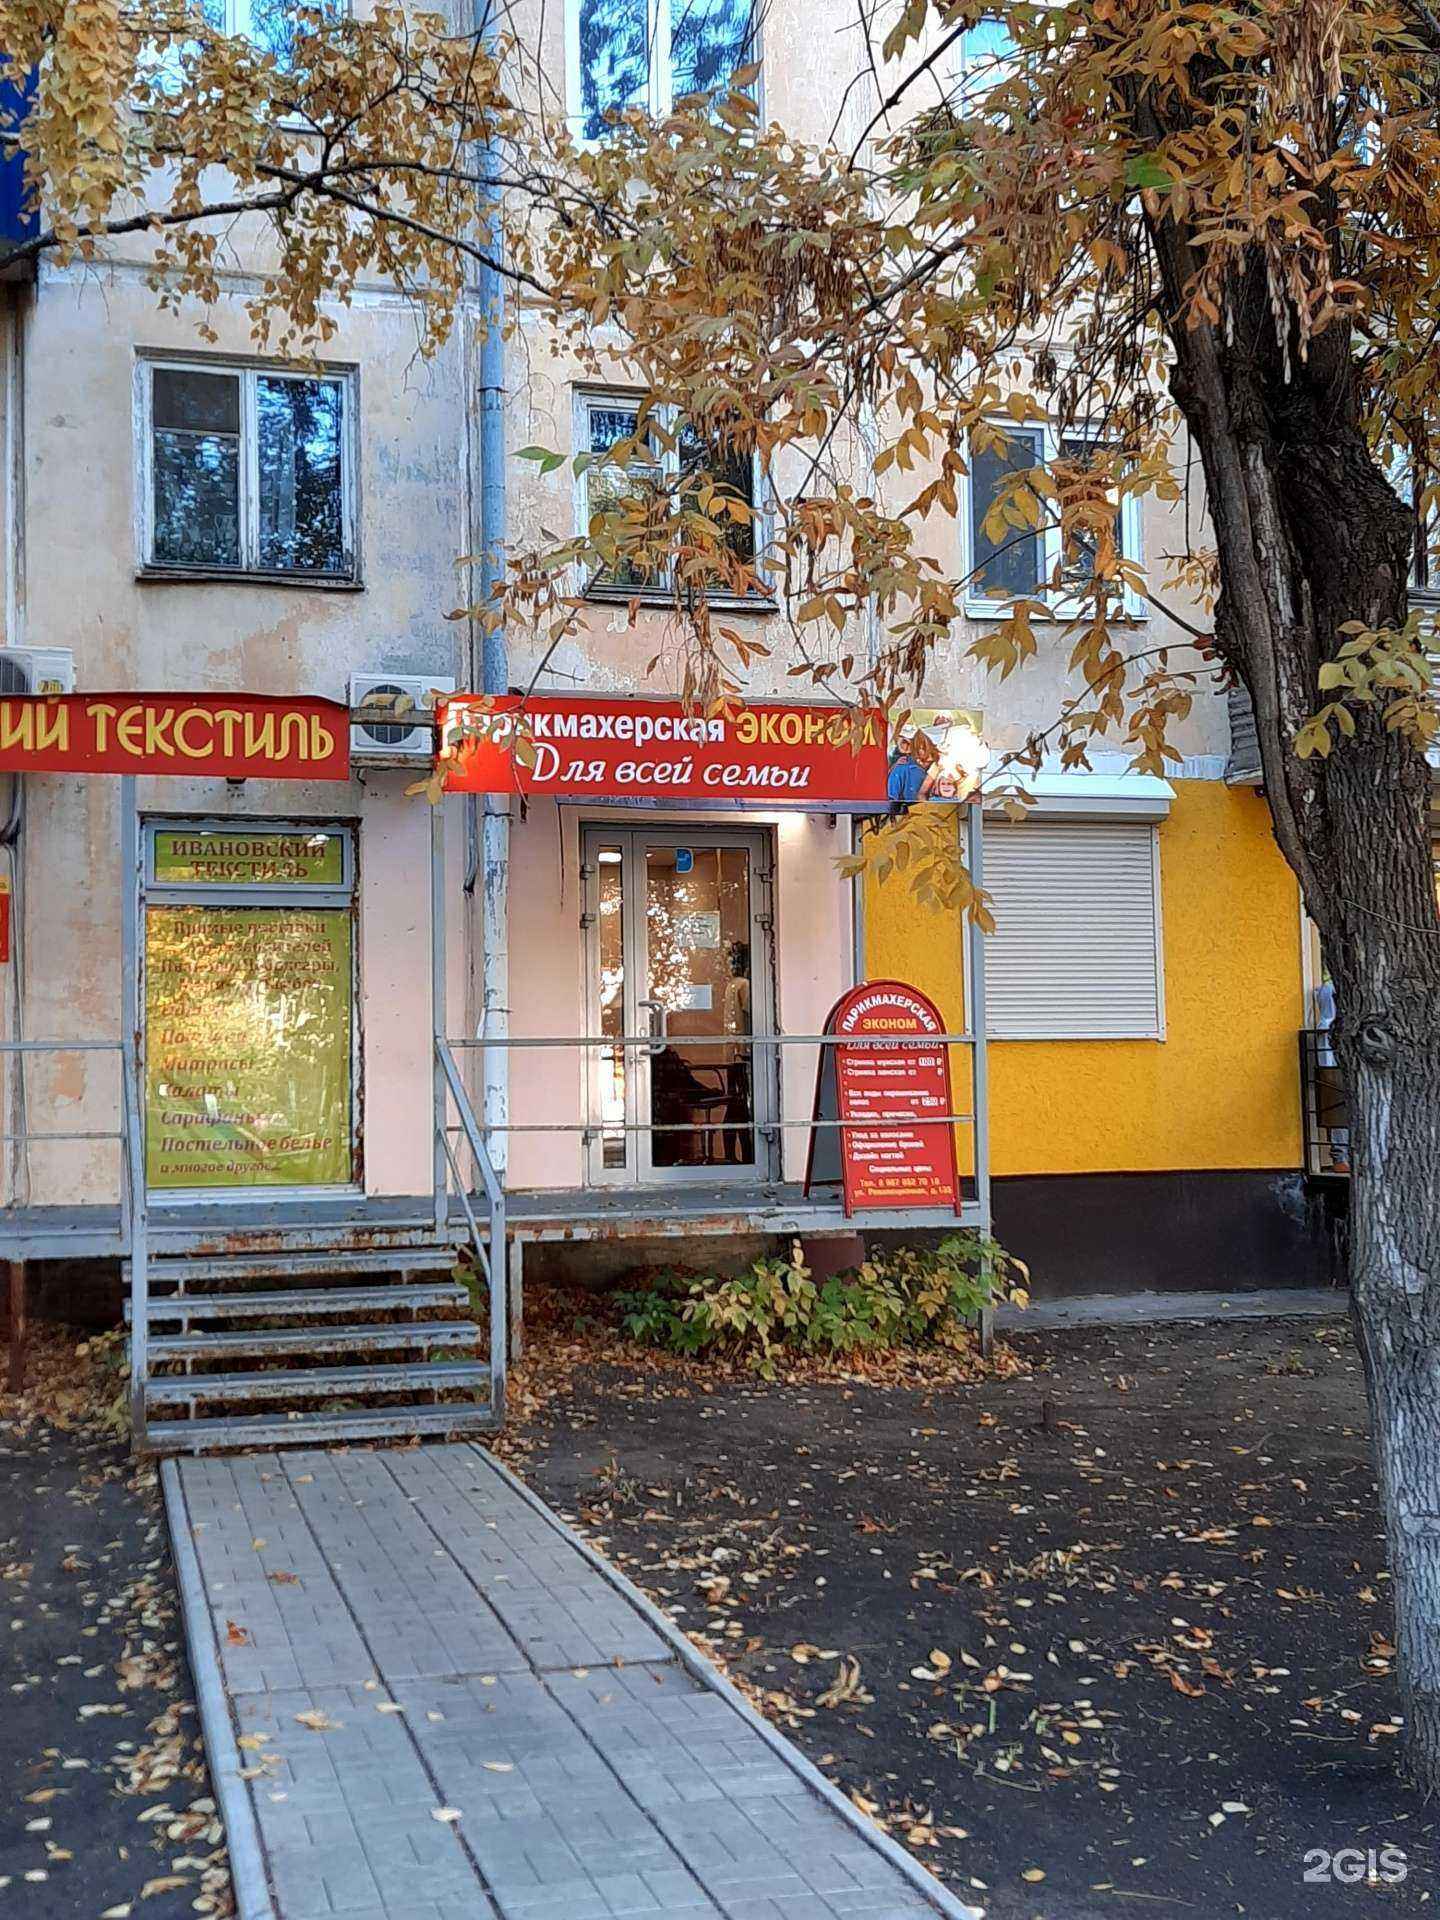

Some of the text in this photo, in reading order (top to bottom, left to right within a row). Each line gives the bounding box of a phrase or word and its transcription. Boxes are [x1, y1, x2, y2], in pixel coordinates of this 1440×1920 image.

[87, 703, 335, 761] ТЕКСТИЛЬ
[516, 742, 811, 787] Для всей семьи
[172, 839, 326, 858] ИВАНОВСКИЙ
[190, 861, 308, 878] ТЕКСТИЛЬ
[842, 993, 937, 1032] ПАРИКМАХЕРСКАЯ
[862, 1018, 917, 1030] ЭКОНОМ
